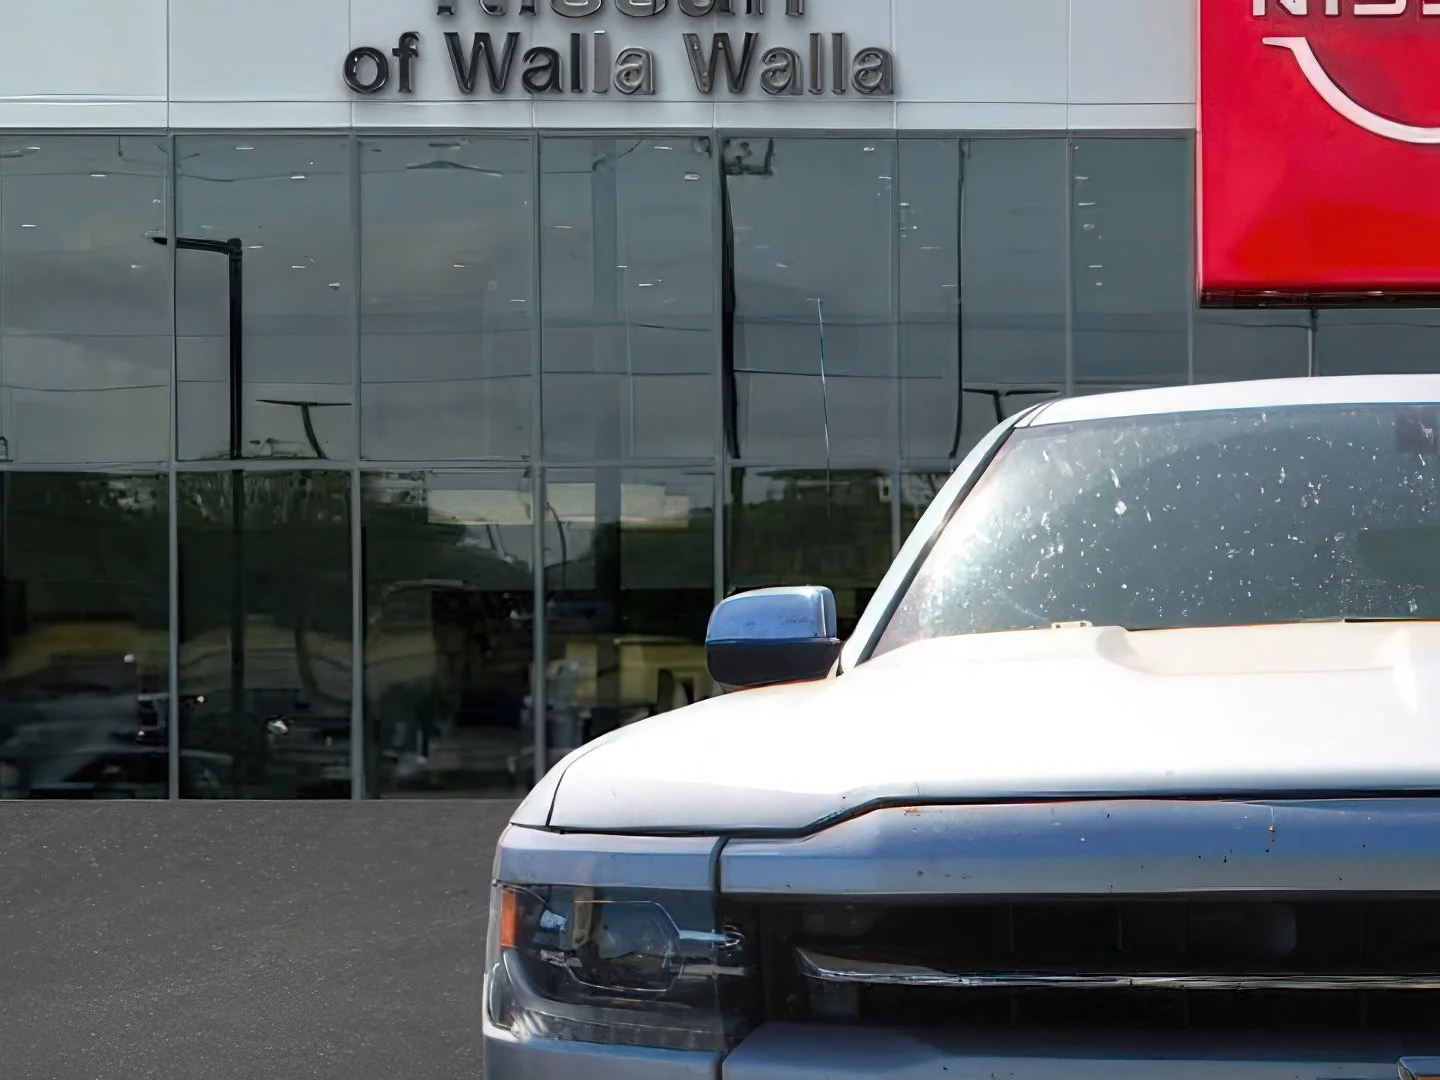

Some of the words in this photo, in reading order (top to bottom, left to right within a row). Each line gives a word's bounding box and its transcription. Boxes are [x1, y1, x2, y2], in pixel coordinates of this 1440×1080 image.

[343, 32, 421, 94] of
[443, 31, 656, 94] Walla
[682, 32, 894, 95] Walla
